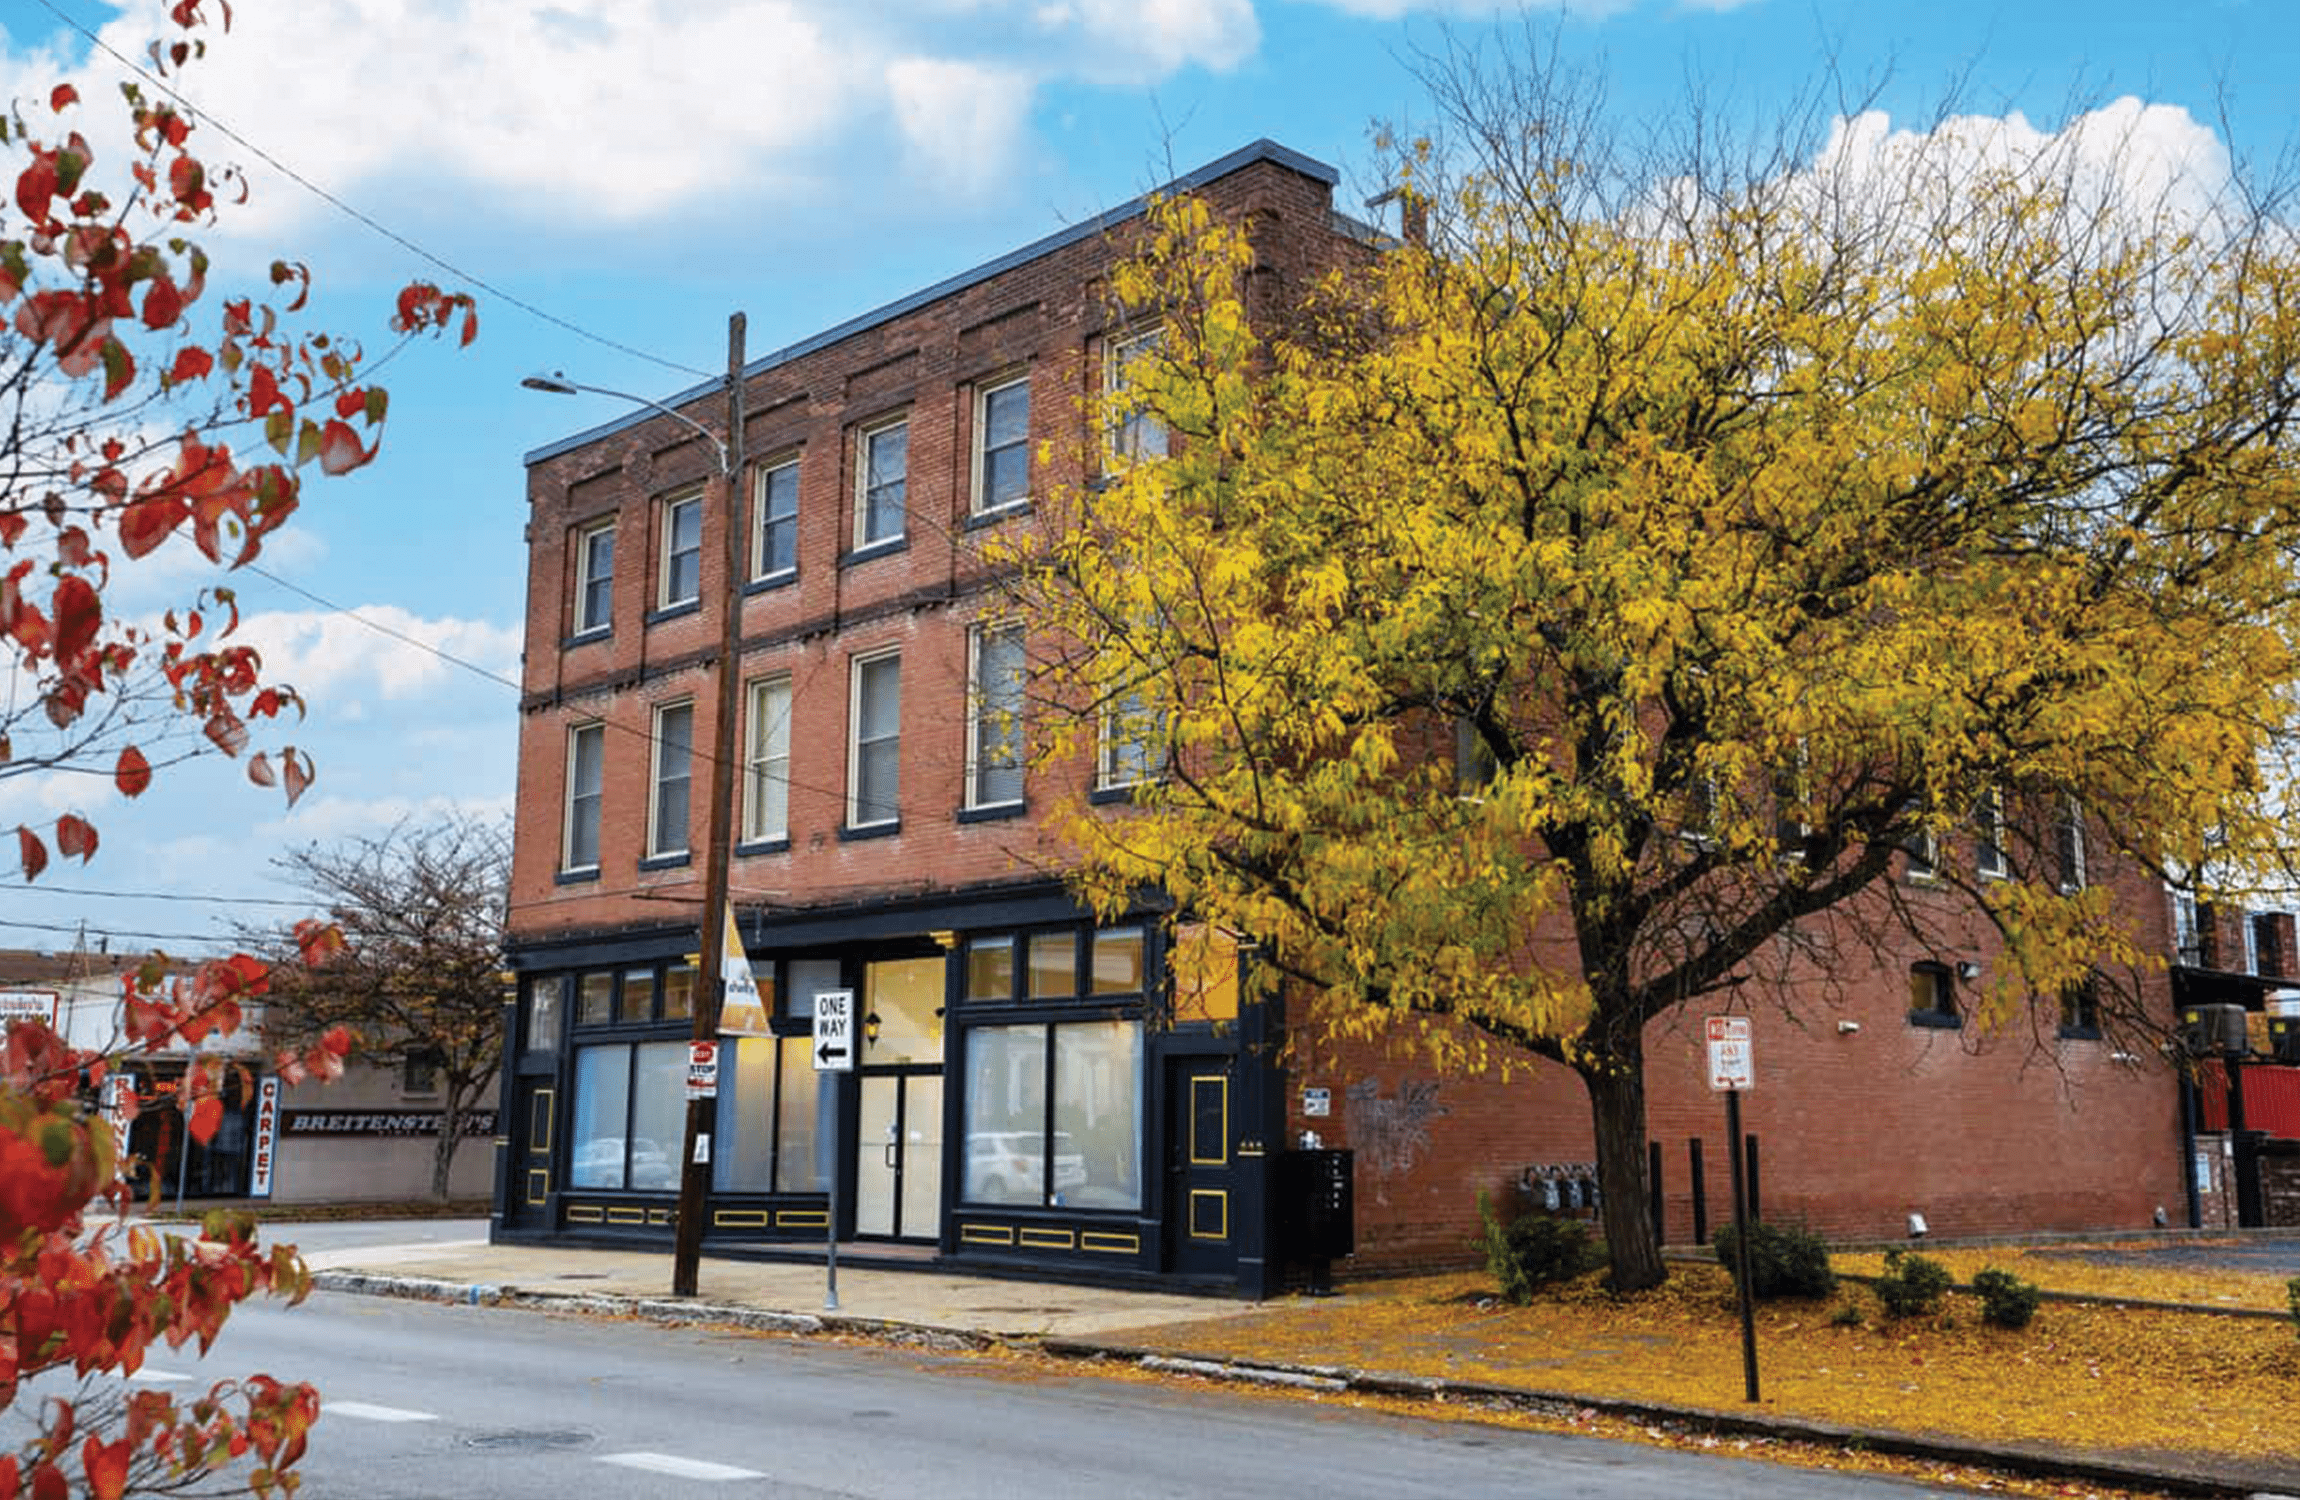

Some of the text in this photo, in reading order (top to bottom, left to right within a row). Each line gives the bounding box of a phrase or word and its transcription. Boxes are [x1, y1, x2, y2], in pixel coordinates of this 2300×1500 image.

[820, 997, 846, 1016] ONE
[820, 1018, 847, 1037] WAY
[690, 1064, 716, 1074] STOP
[290, 1114, 494, 1132] BREITENSTE'S
[256, 1082, 276, 1185] CARPET
